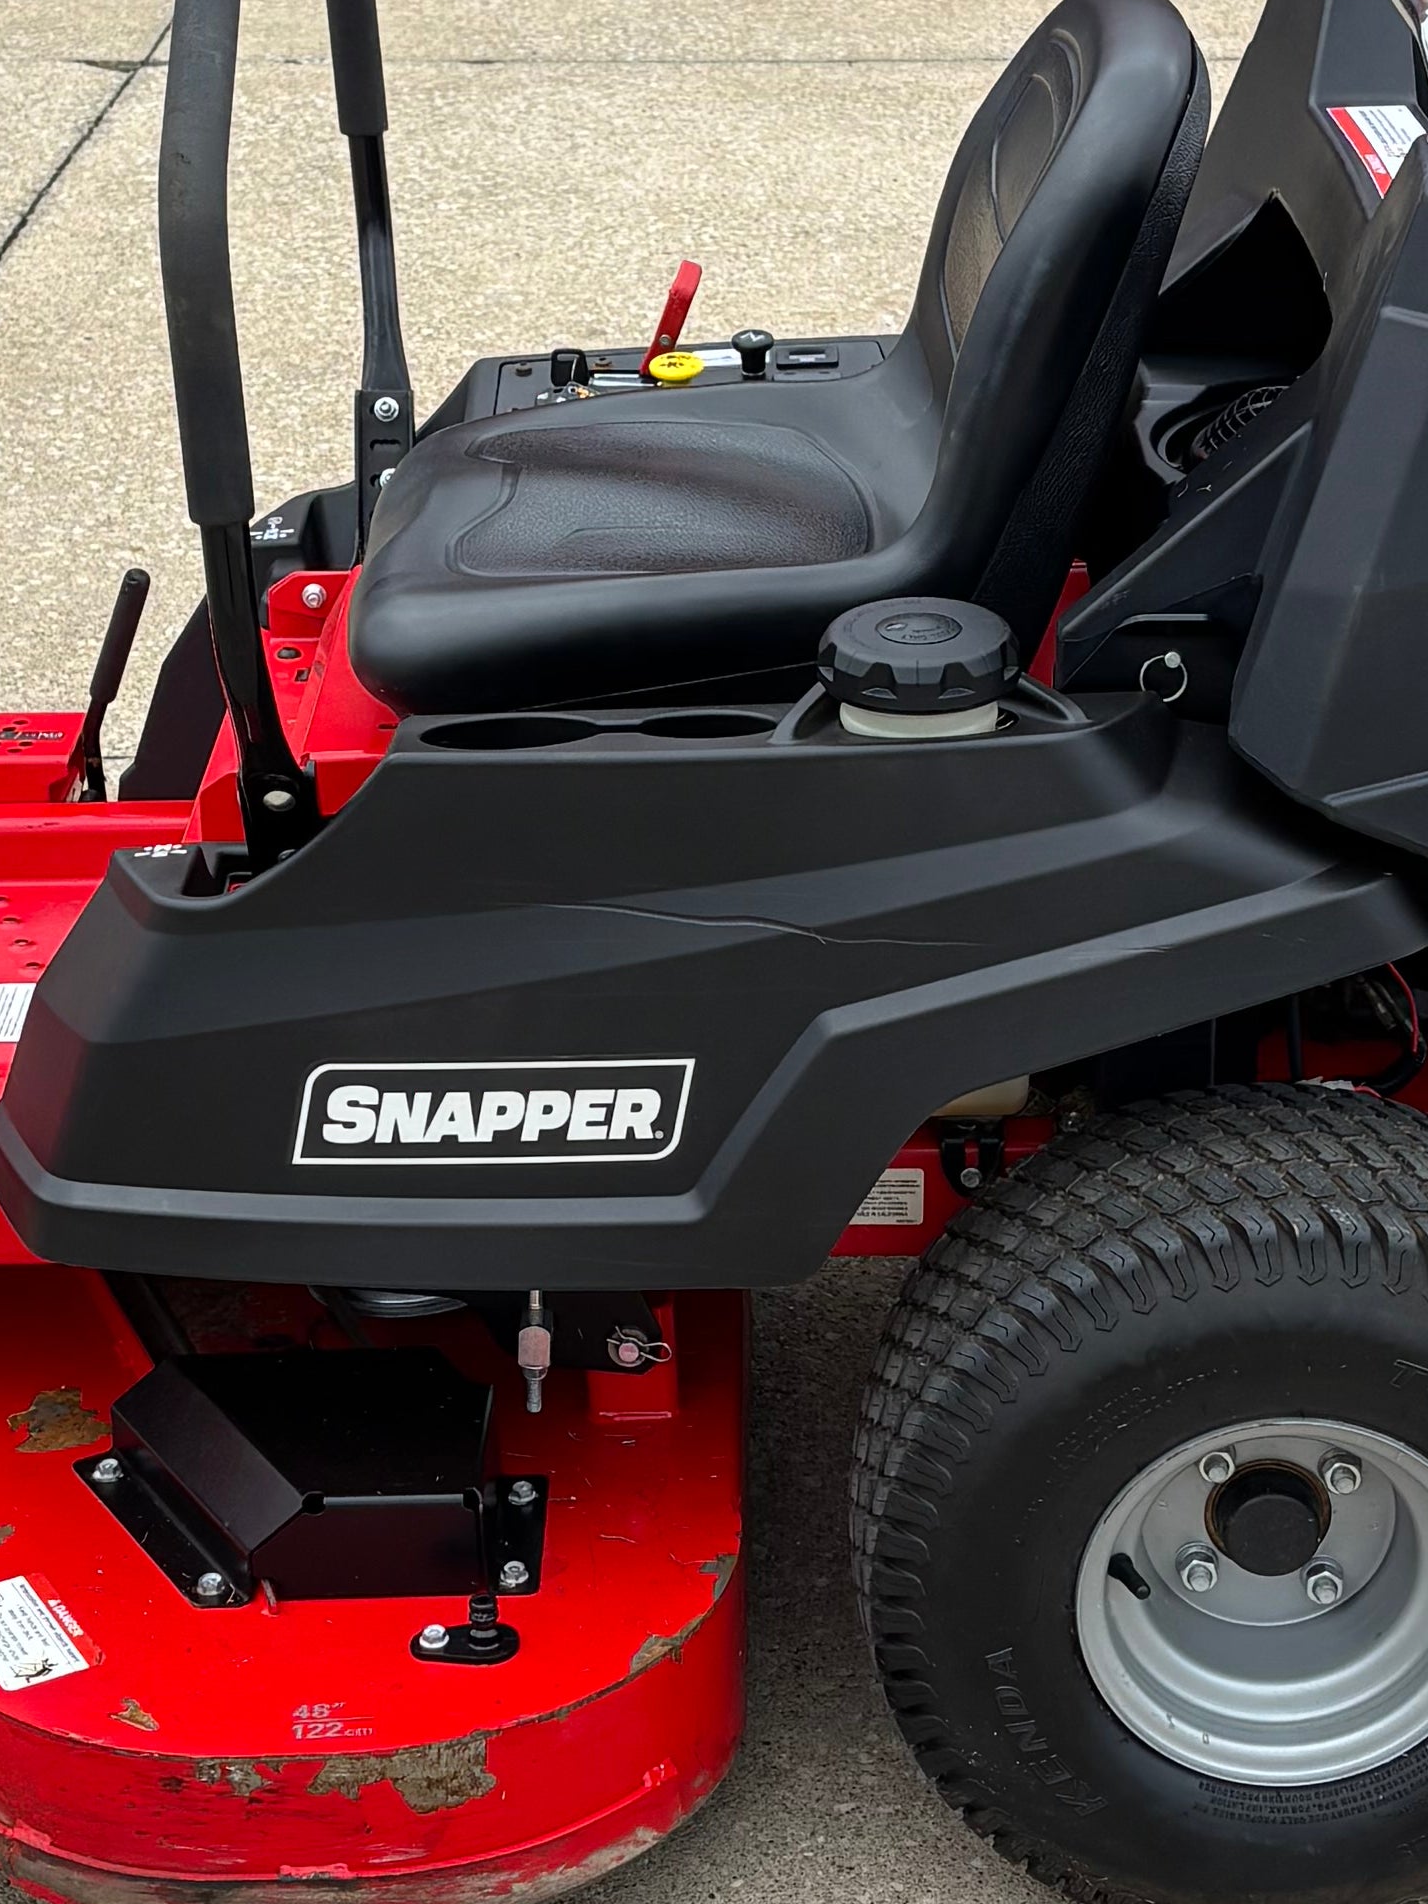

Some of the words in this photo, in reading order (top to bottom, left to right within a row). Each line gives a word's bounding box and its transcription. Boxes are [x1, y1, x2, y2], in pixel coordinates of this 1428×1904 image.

[322, 1085, 661, 1144] SNAPPER
[53, 1604, 84, 1637] DANGER
[985, 1646, 1109, 1817] KENDA
